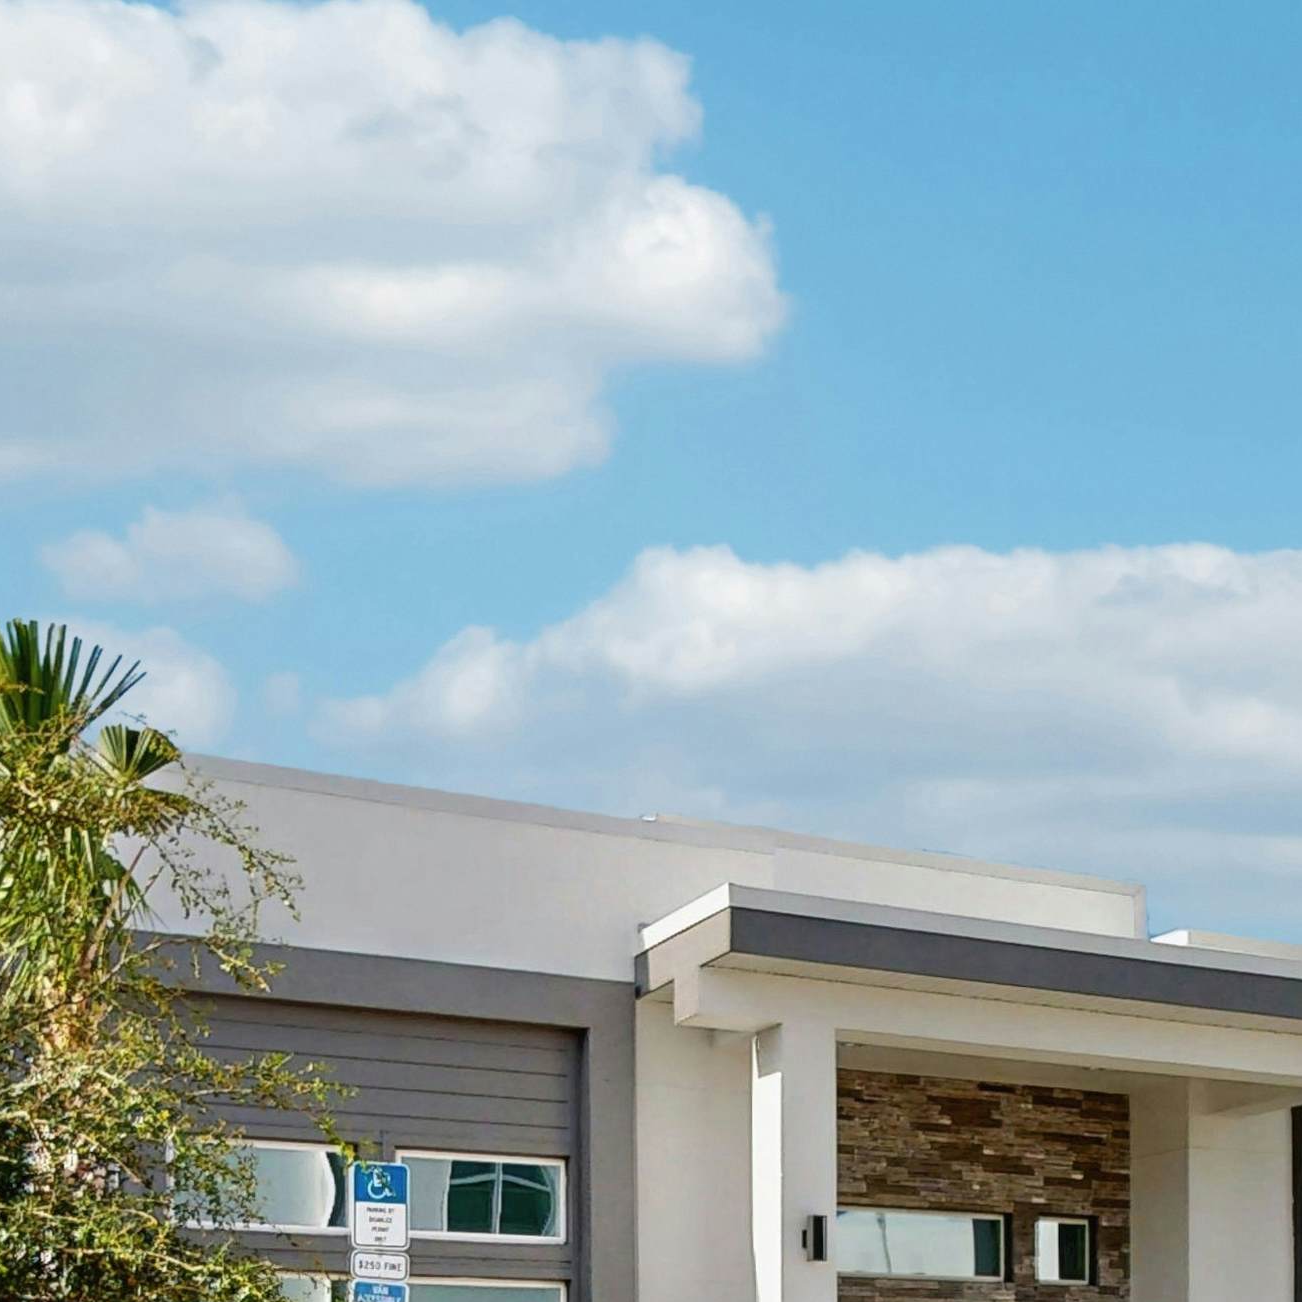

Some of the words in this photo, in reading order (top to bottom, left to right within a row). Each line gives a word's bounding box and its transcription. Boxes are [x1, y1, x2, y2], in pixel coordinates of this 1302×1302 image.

[359, 1260, 381, 1270] $250
[384, 1261, 403, 1271] FINE
[373, 1285, 389, 1295] VAN
